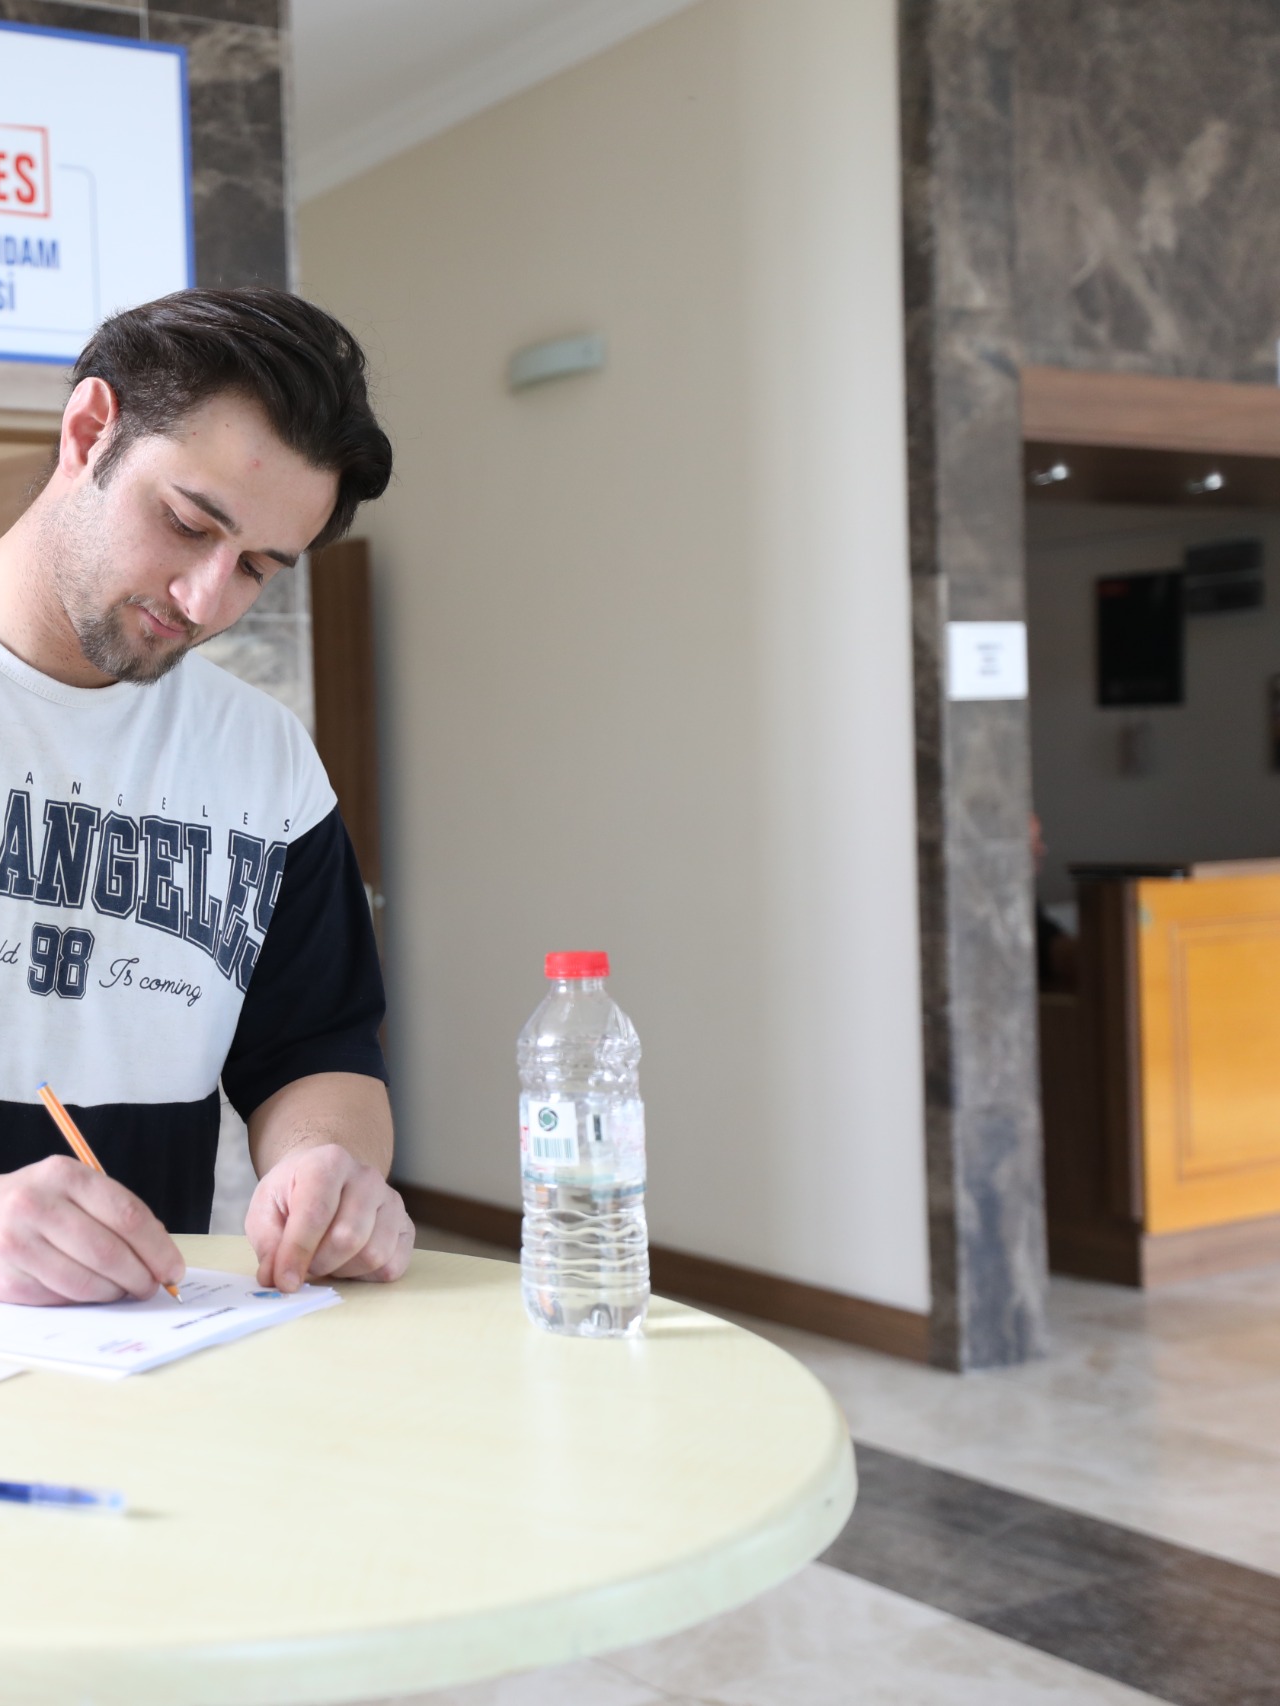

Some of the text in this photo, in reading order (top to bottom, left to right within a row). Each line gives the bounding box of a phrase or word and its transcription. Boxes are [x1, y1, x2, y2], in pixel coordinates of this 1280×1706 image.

[26, 921, 96, 1001] 98
[98, 957, 141, 989] Is
[138, 975, 203, 1008] coming
